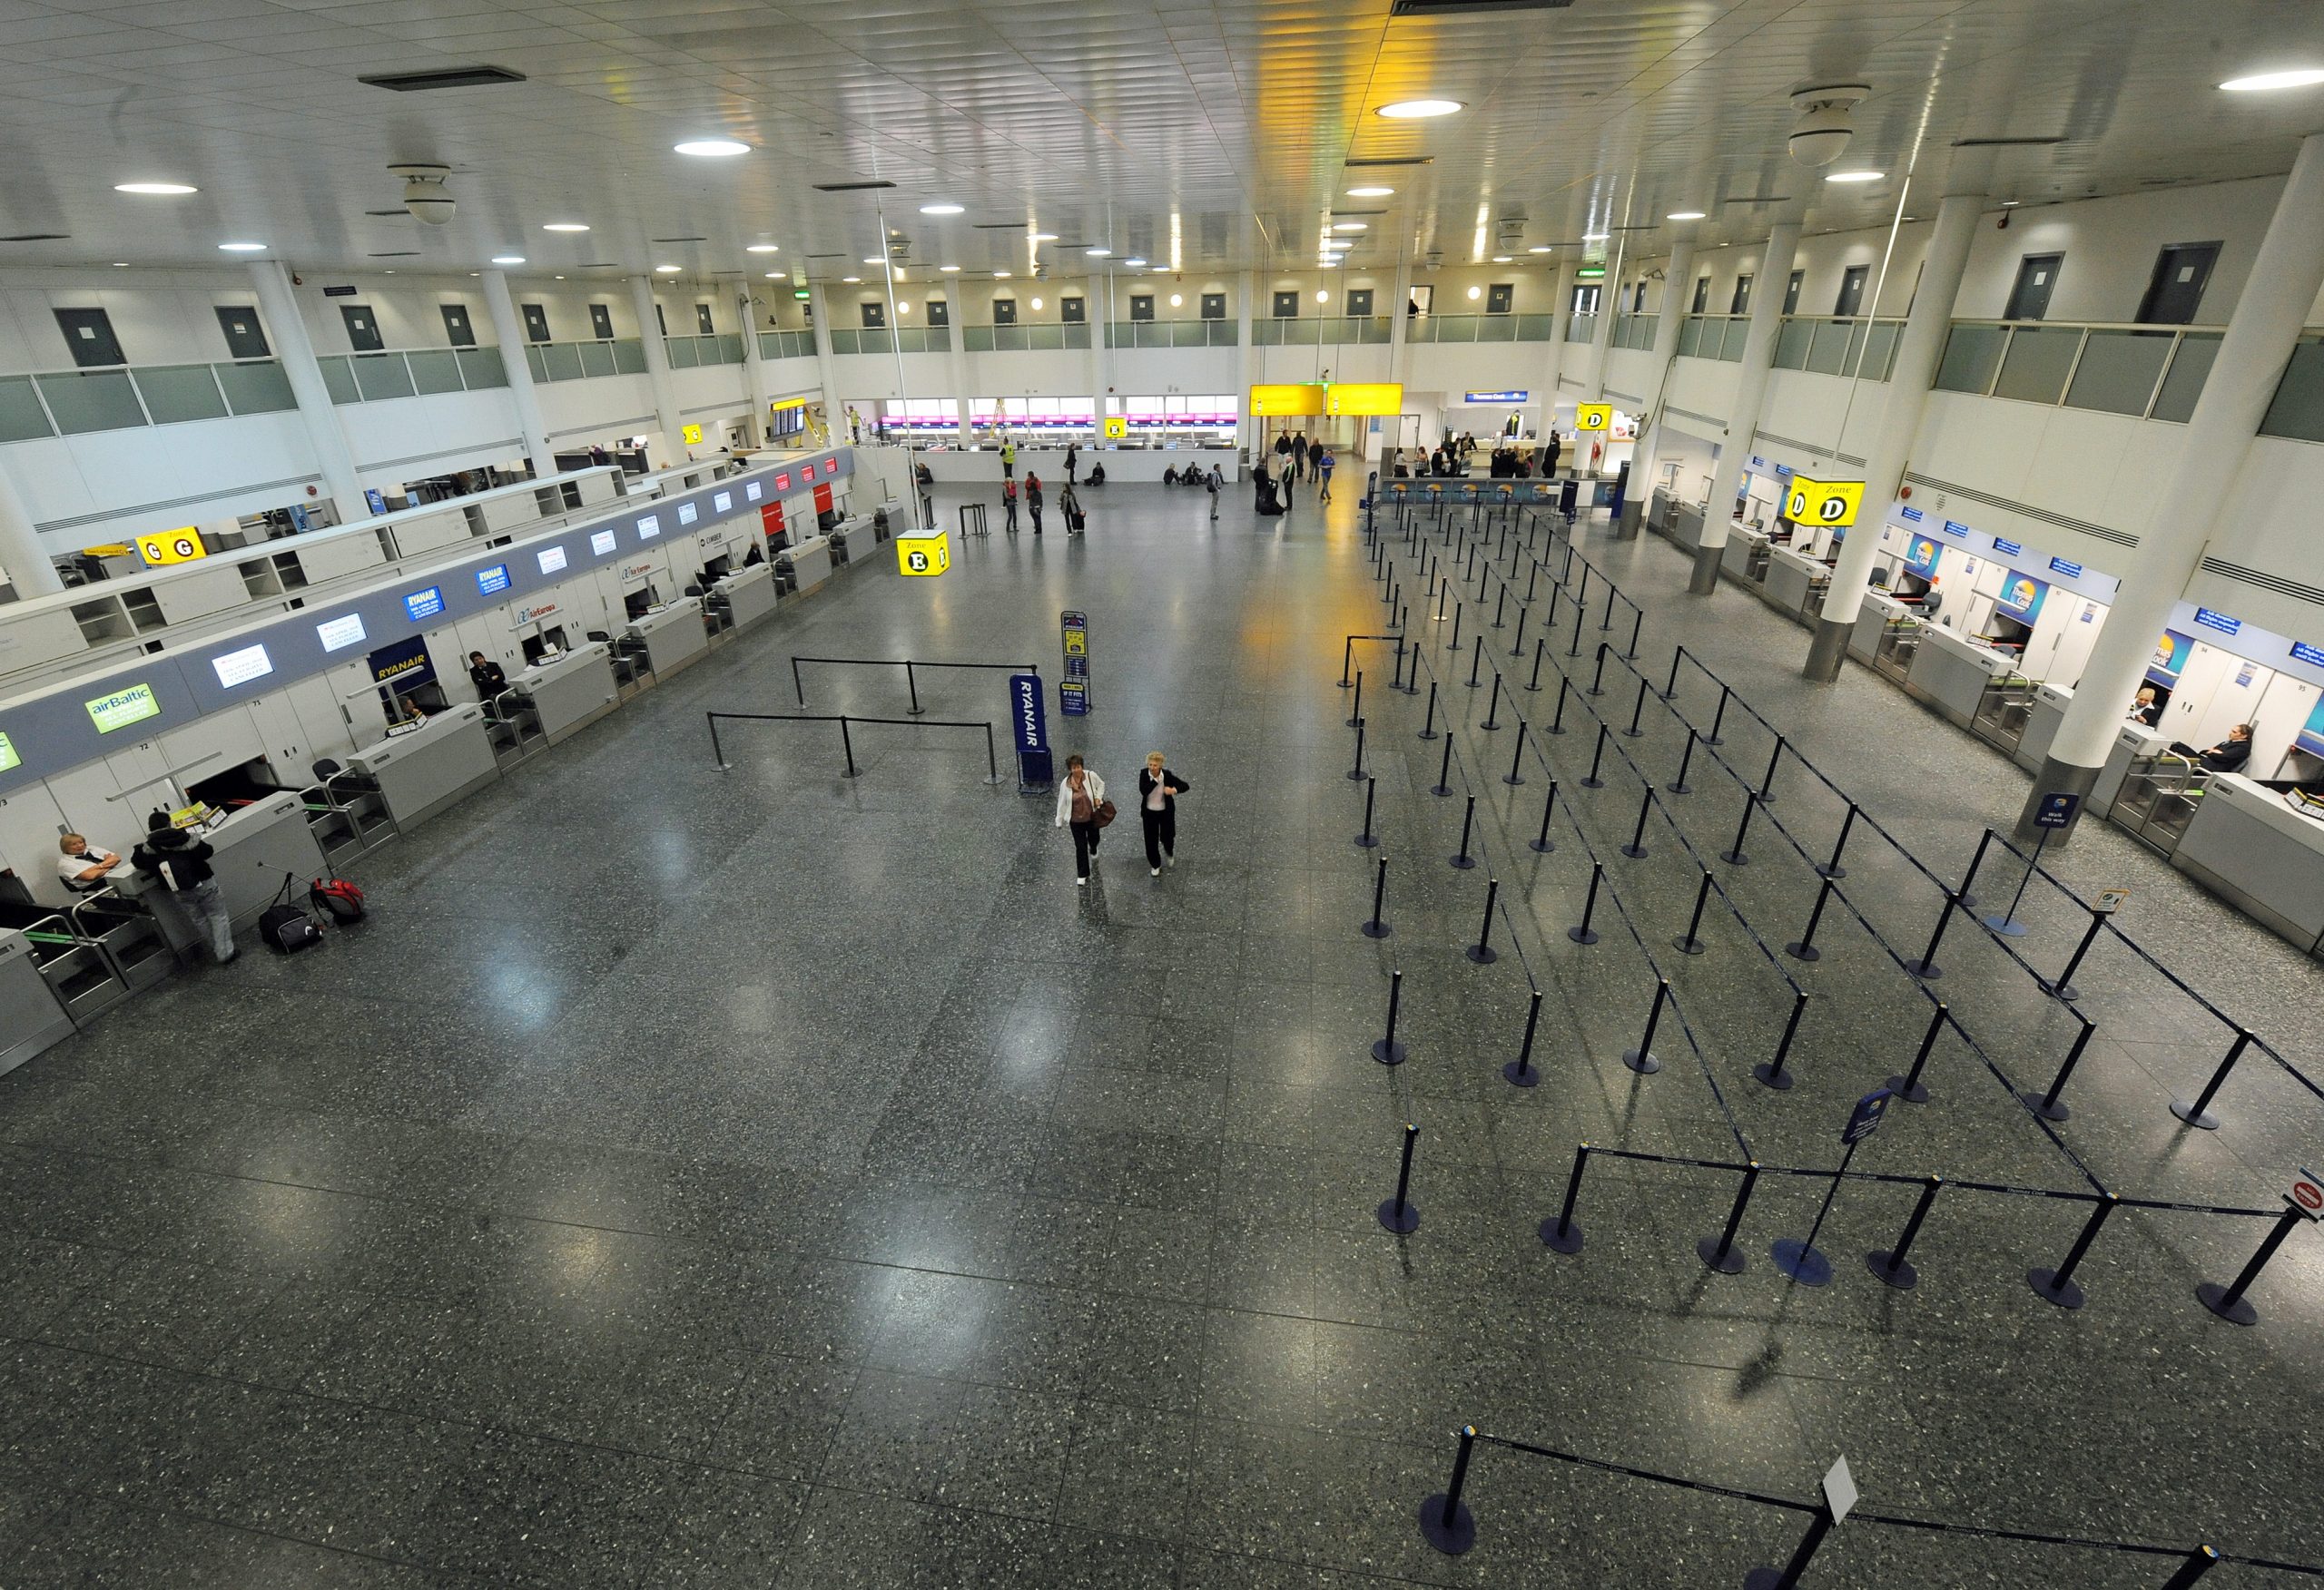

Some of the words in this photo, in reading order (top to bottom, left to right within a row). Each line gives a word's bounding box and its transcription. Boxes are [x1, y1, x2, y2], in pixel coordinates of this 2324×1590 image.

[1589, 415, 1601, 427] D
[1793, 495, 1805, 515] D
[1821, 499, 1844, 519] D
[706, 532, 722, 545] CIMBER
[148, 545, 161, 560] G
[175, 540, 192, 556] G
[911, 553, 926, 570] E
[478, 566, 503, 583] RYANAIR
[408, 589, 437, 607] RYANAIR
[2013, 585, 2034, 603] Thomas
[2016, 597, 2031, 610] Cook
[379, 654, 425, 680] RYANAIR
[2152, 654, 2169, 667] ook
[92, 689, 150, 714] airBaltic
[1020, 681, 1038, 747] RYANAIR
[139, 742, 149, 751] 72
[1661, 1156, 1681, 1164] Thomas
[2007, 1187, 2030, 1195] Thomas
[2297, 1192, 2315, 1207] ENTRY
[2171, 1203, 2196, 1212] Thomas
[2197, 1205, 2213, 1213] Cook
[1493, 1438, 1512, 1448] Cook
[1578, 1458, 1608, 1469] Thomas
[1609, 1465, 1629, 1474] Cook
[1693, 1483, 1726, 1494] Thomas
[1727, 1490, 1748, 1498] Cook
[1945, 1525, 1974, 1534] Thomas
